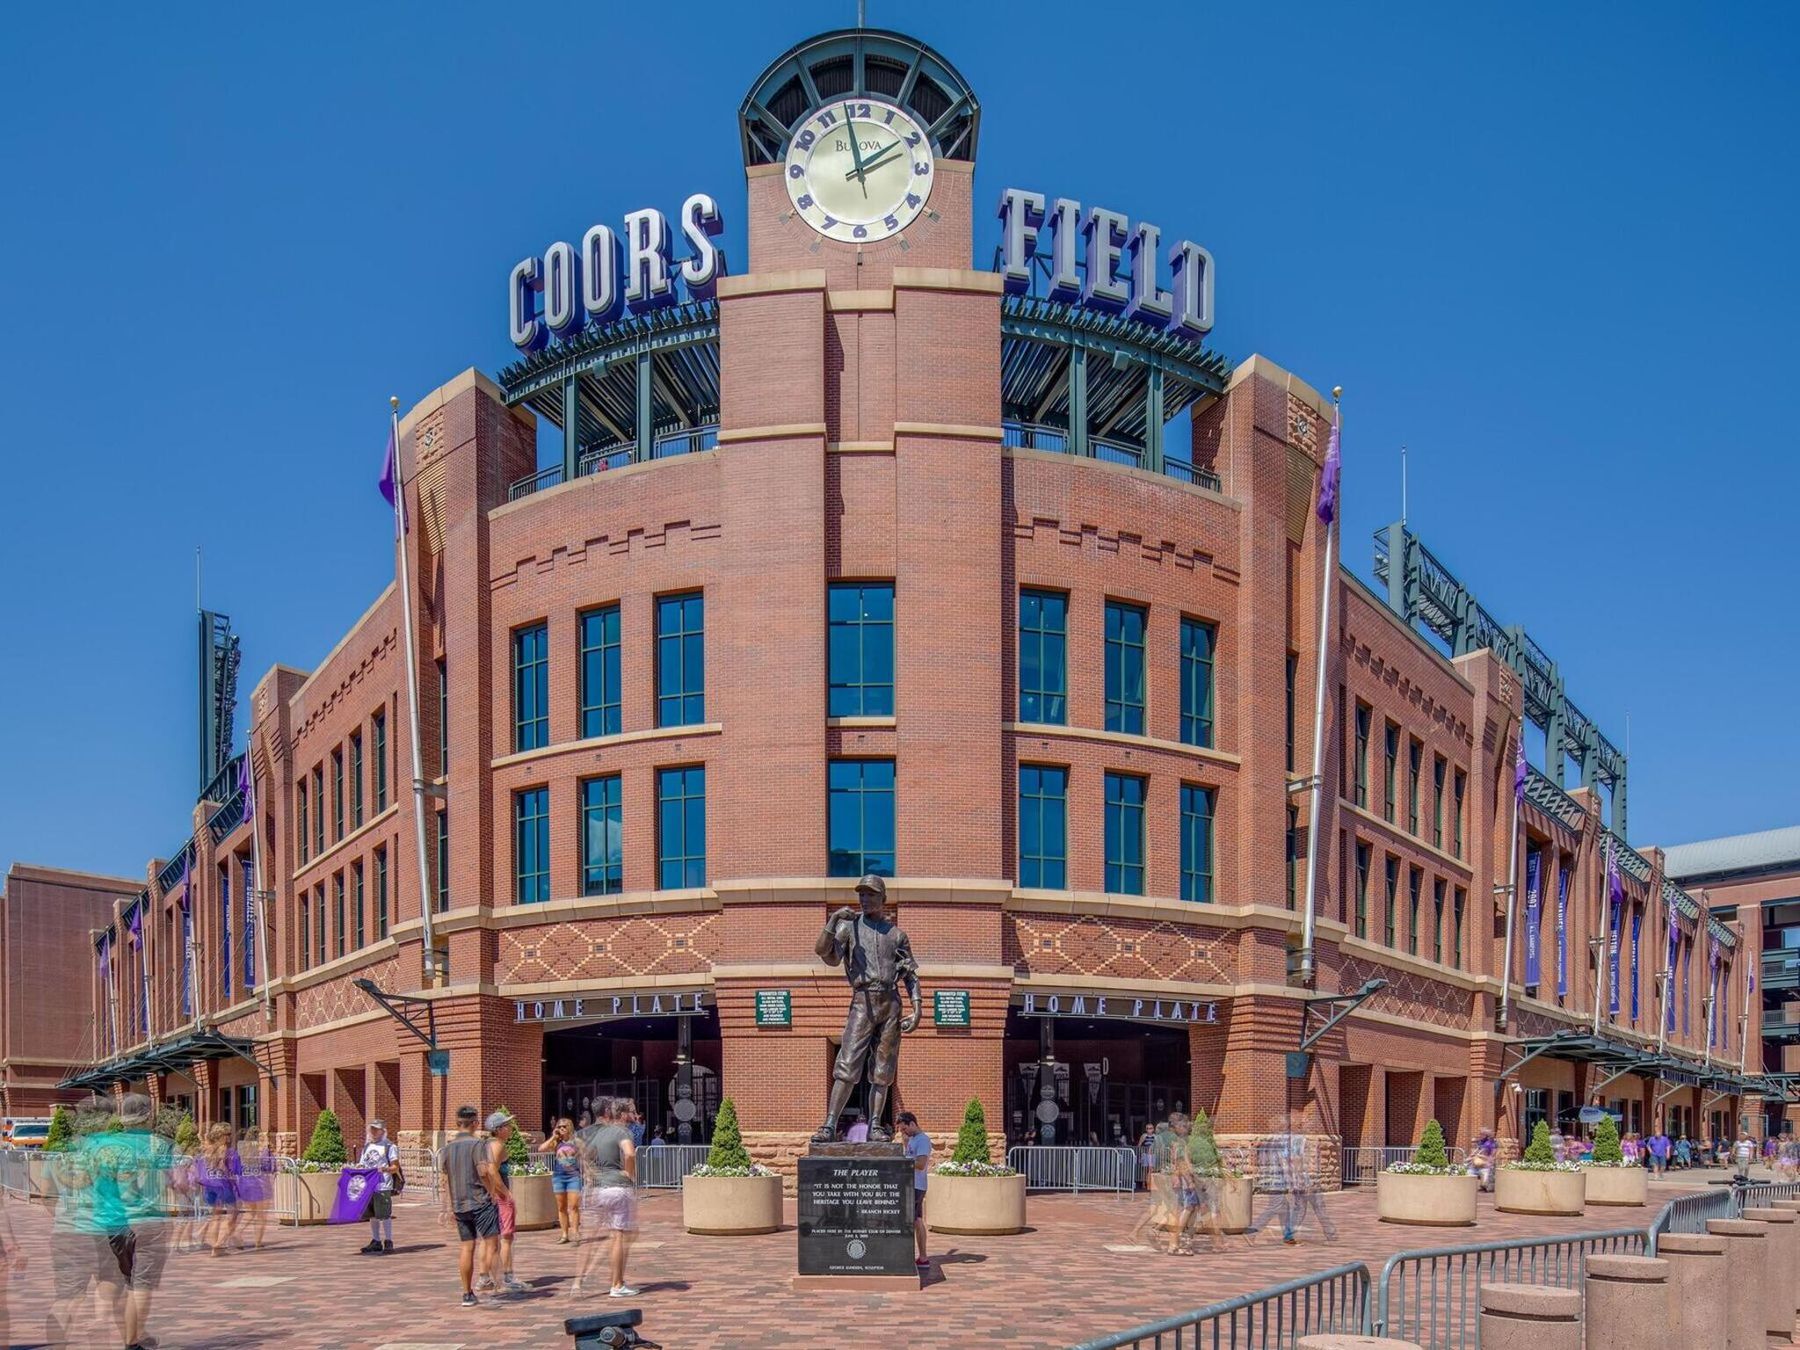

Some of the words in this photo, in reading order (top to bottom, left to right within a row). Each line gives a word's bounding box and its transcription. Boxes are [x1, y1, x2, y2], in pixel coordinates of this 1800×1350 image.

[817, 110, 837, 129] 11
[847, 103, 871, 119] 12
[883, 109, 897, 125] 1
[794, 129, 816, 151] 10
[835, 140, 882, 151] BUOVA
[903, 131, 921, 149] 2
[789, 164, 805, 179] 9
[914, 162, 930, 176] 3
[796, 193, 814, 210] 8
[905, 192, 922, 210] 4
[821, 215, 839, 230] 7
[883, 213, 899, 232] 5
[853, 224, 868, 239] 6
[509, 193, 723, 350] COORS
[998, 188, 1215, 338] FIELD
[516, 999, 583, 1020] HOME
[613, 993, 704, 1015] PLATE
[1023, 993, 1107, 1014] HOME
[1133, 999, 1217, 1021] PLATE
